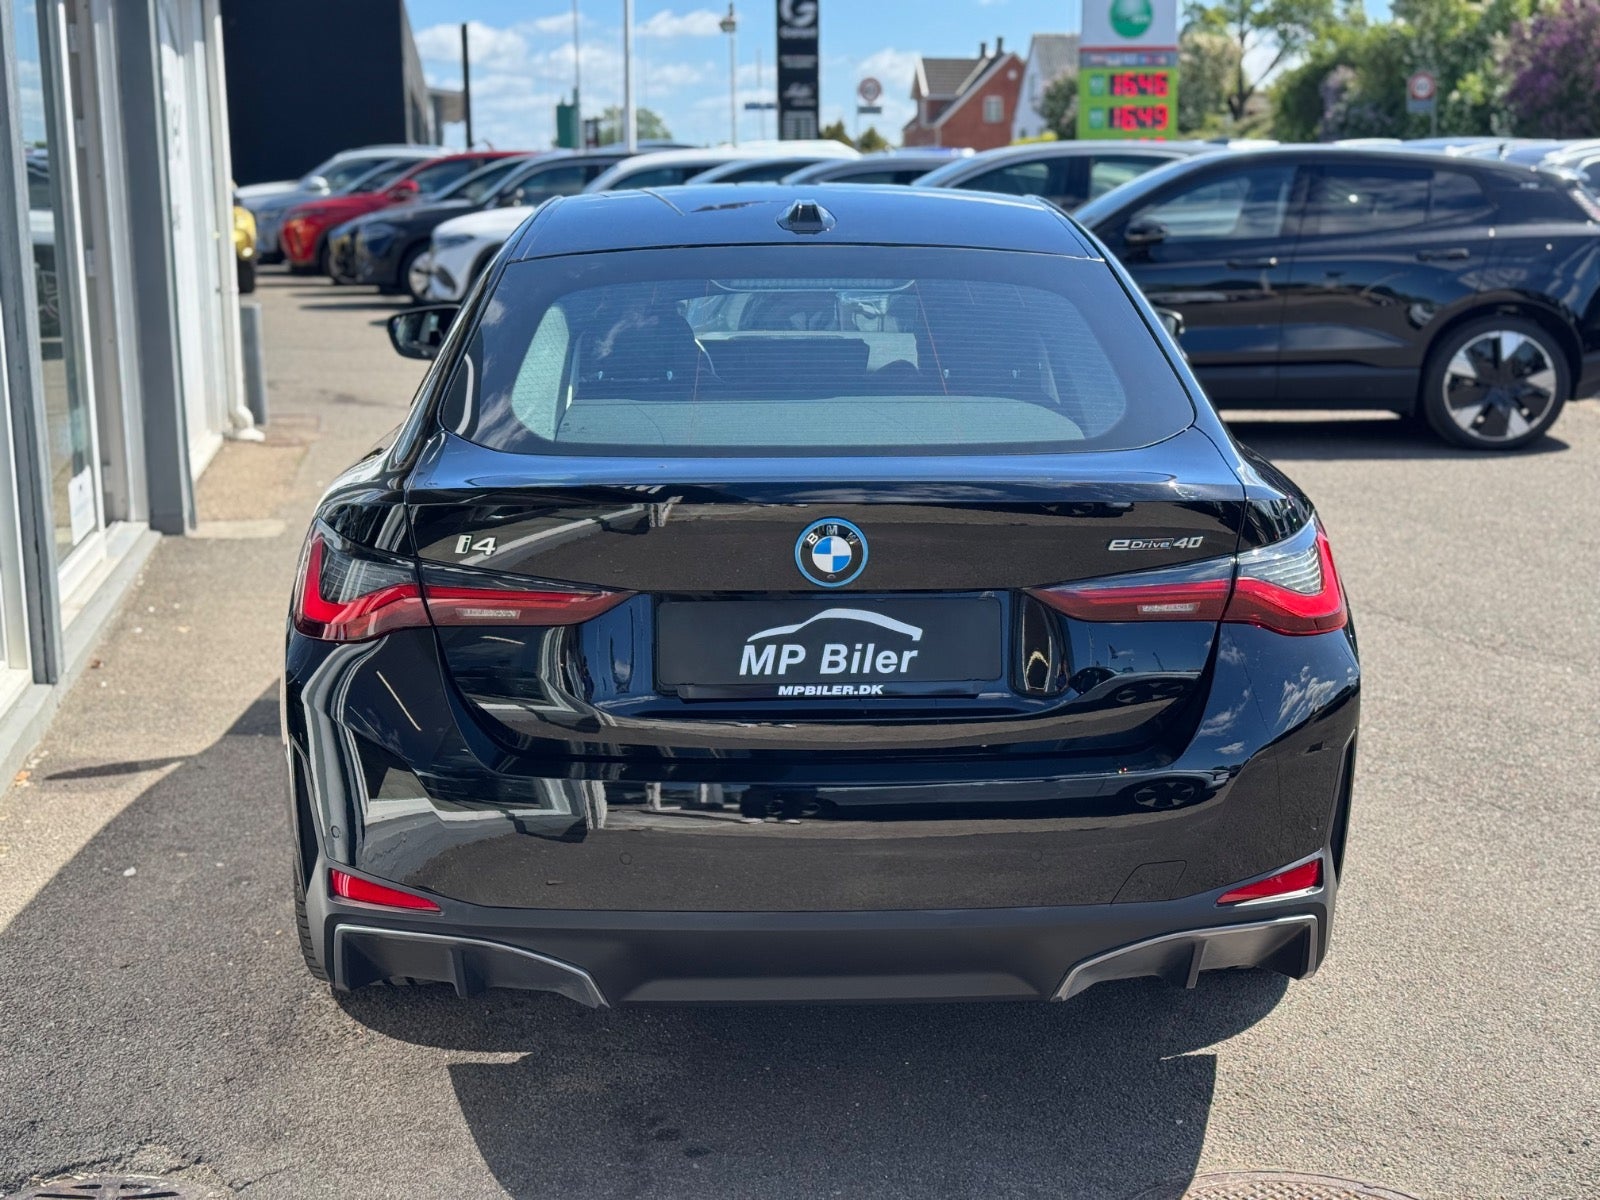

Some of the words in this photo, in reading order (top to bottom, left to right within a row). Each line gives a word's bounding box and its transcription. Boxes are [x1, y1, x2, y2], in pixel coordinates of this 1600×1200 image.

[806, 524, 860, 545] BMW
[1173, 536, 1204, 549] 40
[455, 535, 496, 555] i4
[739, 644, 807, 676] MP
[819, 643, 919, 675] Biler
[778, 684, 885, 696] MPBILER.DK
